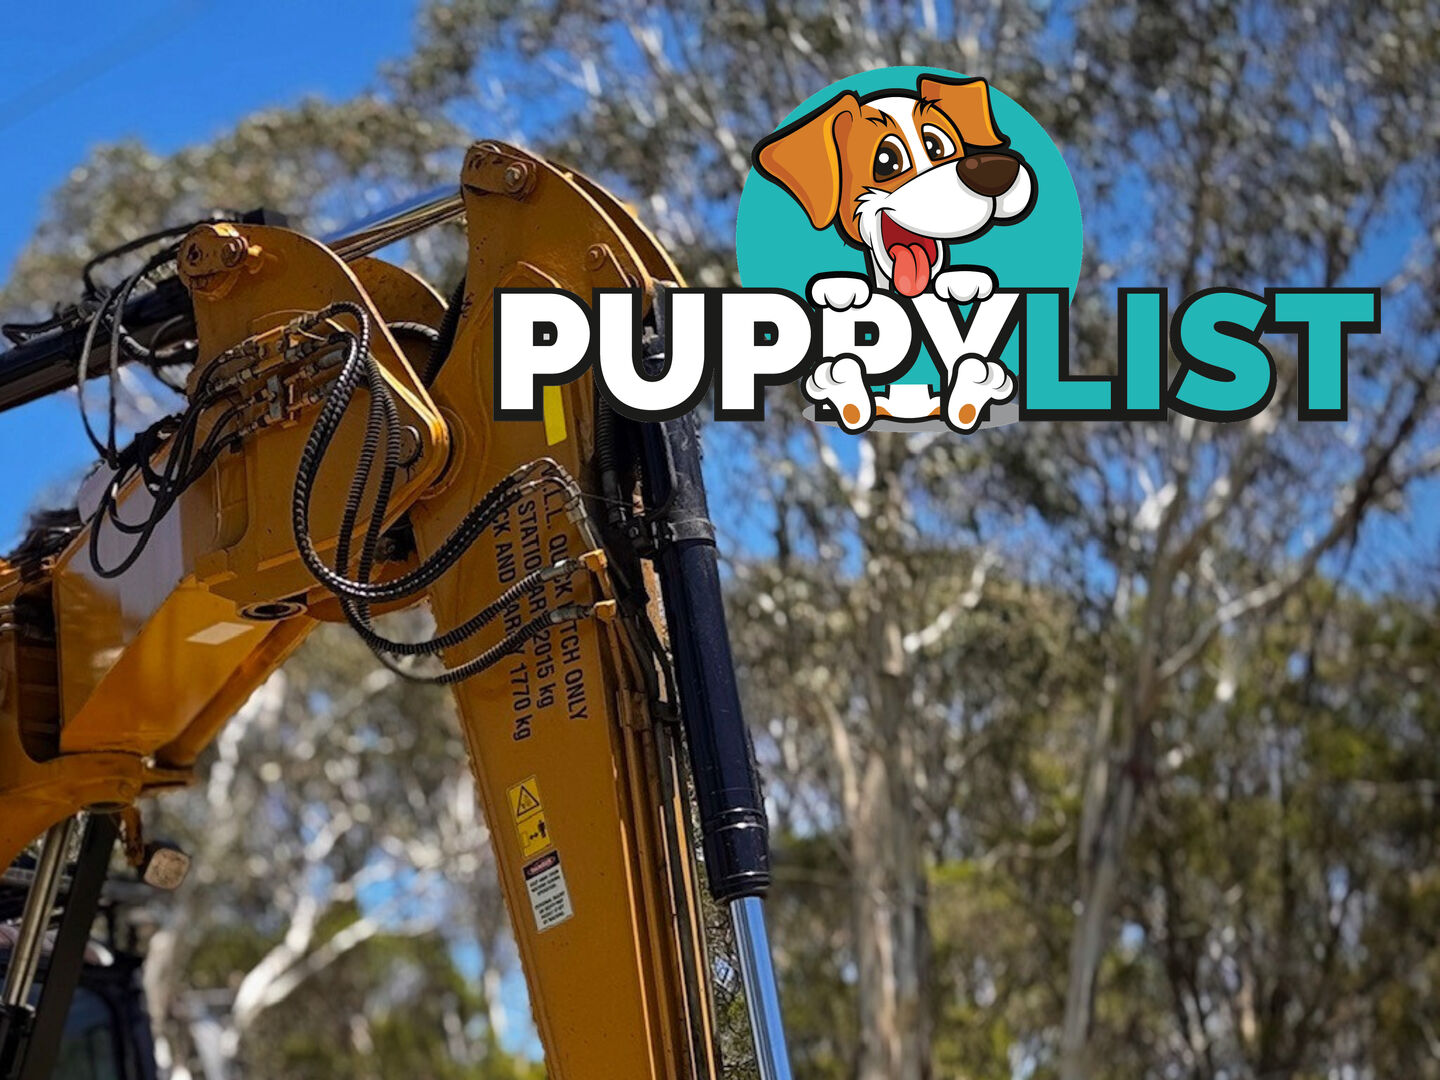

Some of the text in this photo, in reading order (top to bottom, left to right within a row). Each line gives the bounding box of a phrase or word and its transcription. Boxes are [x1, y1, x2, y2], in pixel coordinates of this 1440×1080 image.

[495, 542, 516, 583] AND
[532, 628, 555, 680] 2015
[509, 661, 531, 712] 1770
[536, 682, 557, 710] kg
[564, 667, 588, 721] ONLY
[513, 713, 533, 742] kg
